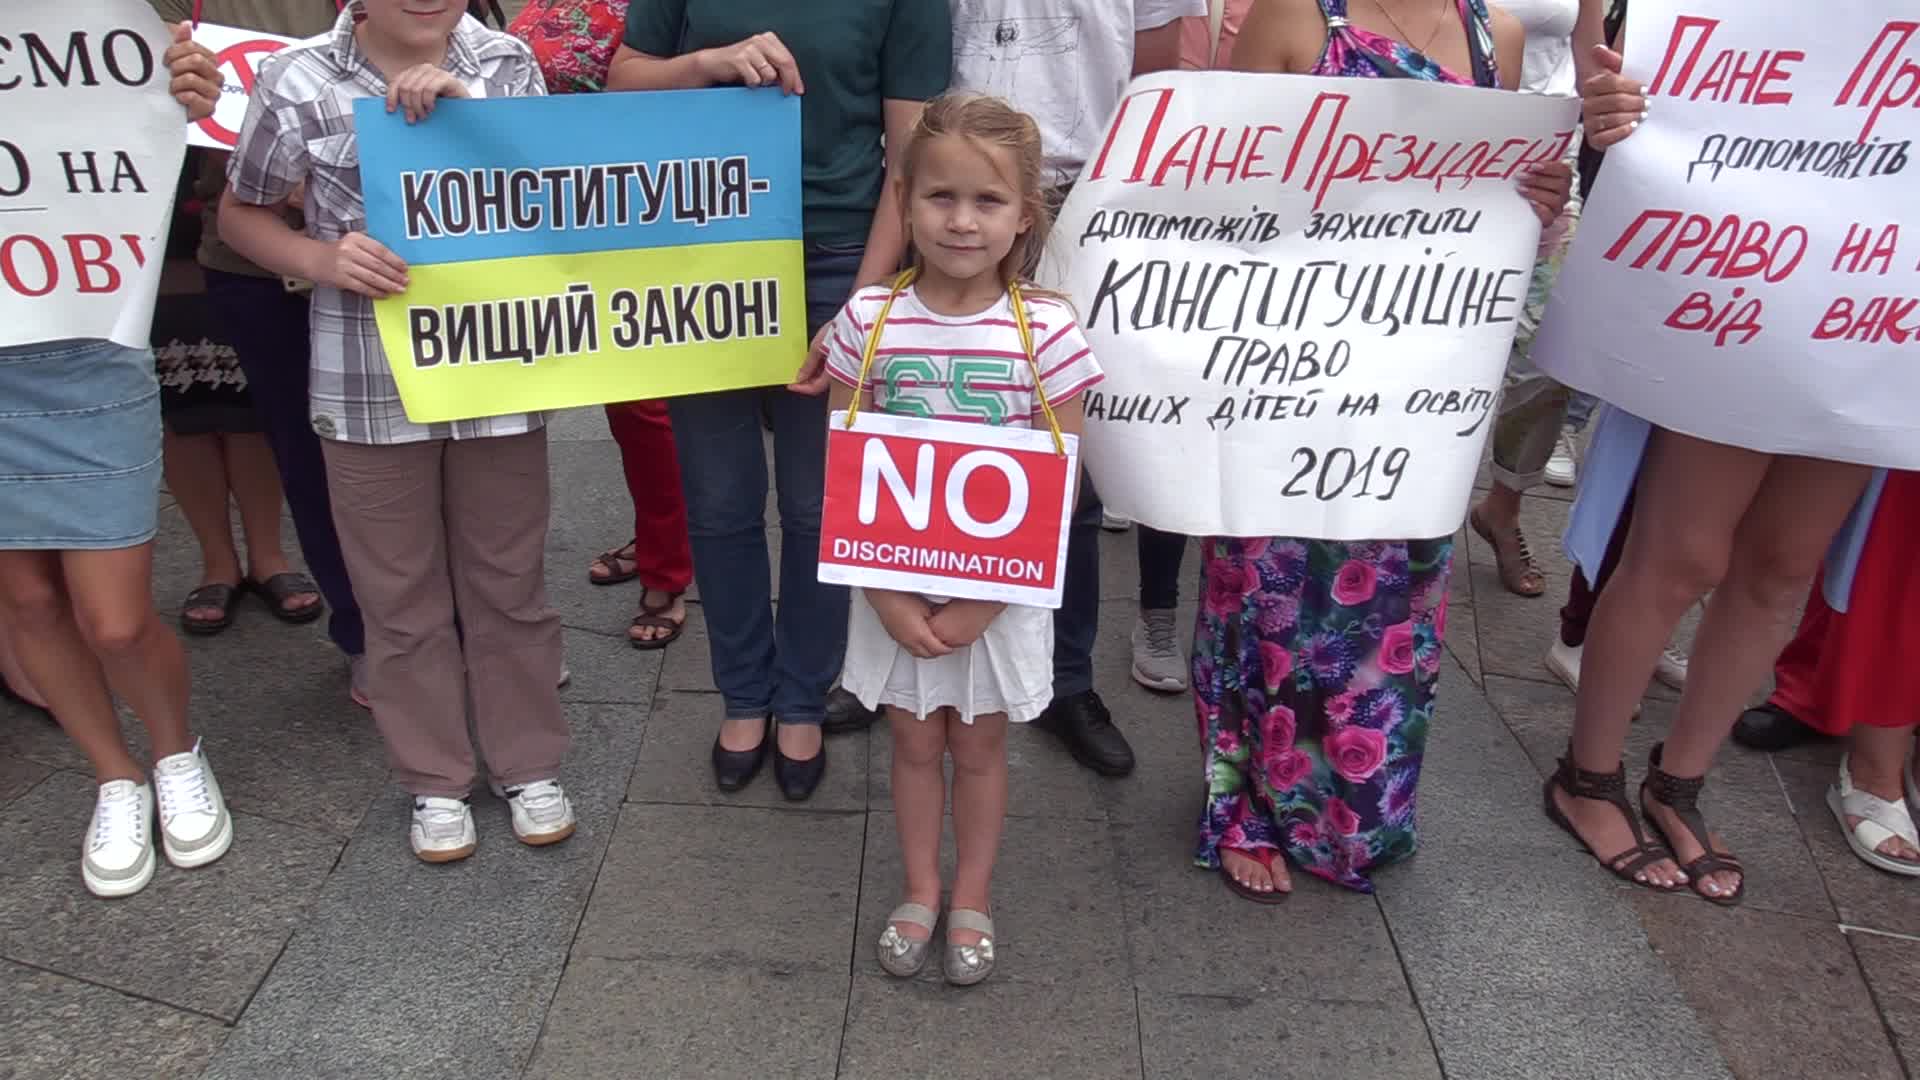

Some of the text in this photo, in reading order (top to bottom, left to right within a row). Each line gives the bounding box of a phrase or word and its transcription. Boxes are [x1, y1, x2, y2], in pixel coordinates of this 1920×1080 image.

[1834, 21, 1920, 144] ПР
[57, 151, 149, 194] НА
[400, 155, 770, 240] КОНСТИТУЦІЯ-
[1602, 209, 1899, 283] ПРАВО НА
[407, 279, 780, 368] ВИЩИЙ ЗАКОН!
[1202, 336, 1351, 386] ПРАВО
[1337, 392, 1379, 417] НА
[858, 437, 1030, 539] NO
[1281, 446, 1410, 500] 2019
[832, 538, 1044, 581] DISCRIMINATION
